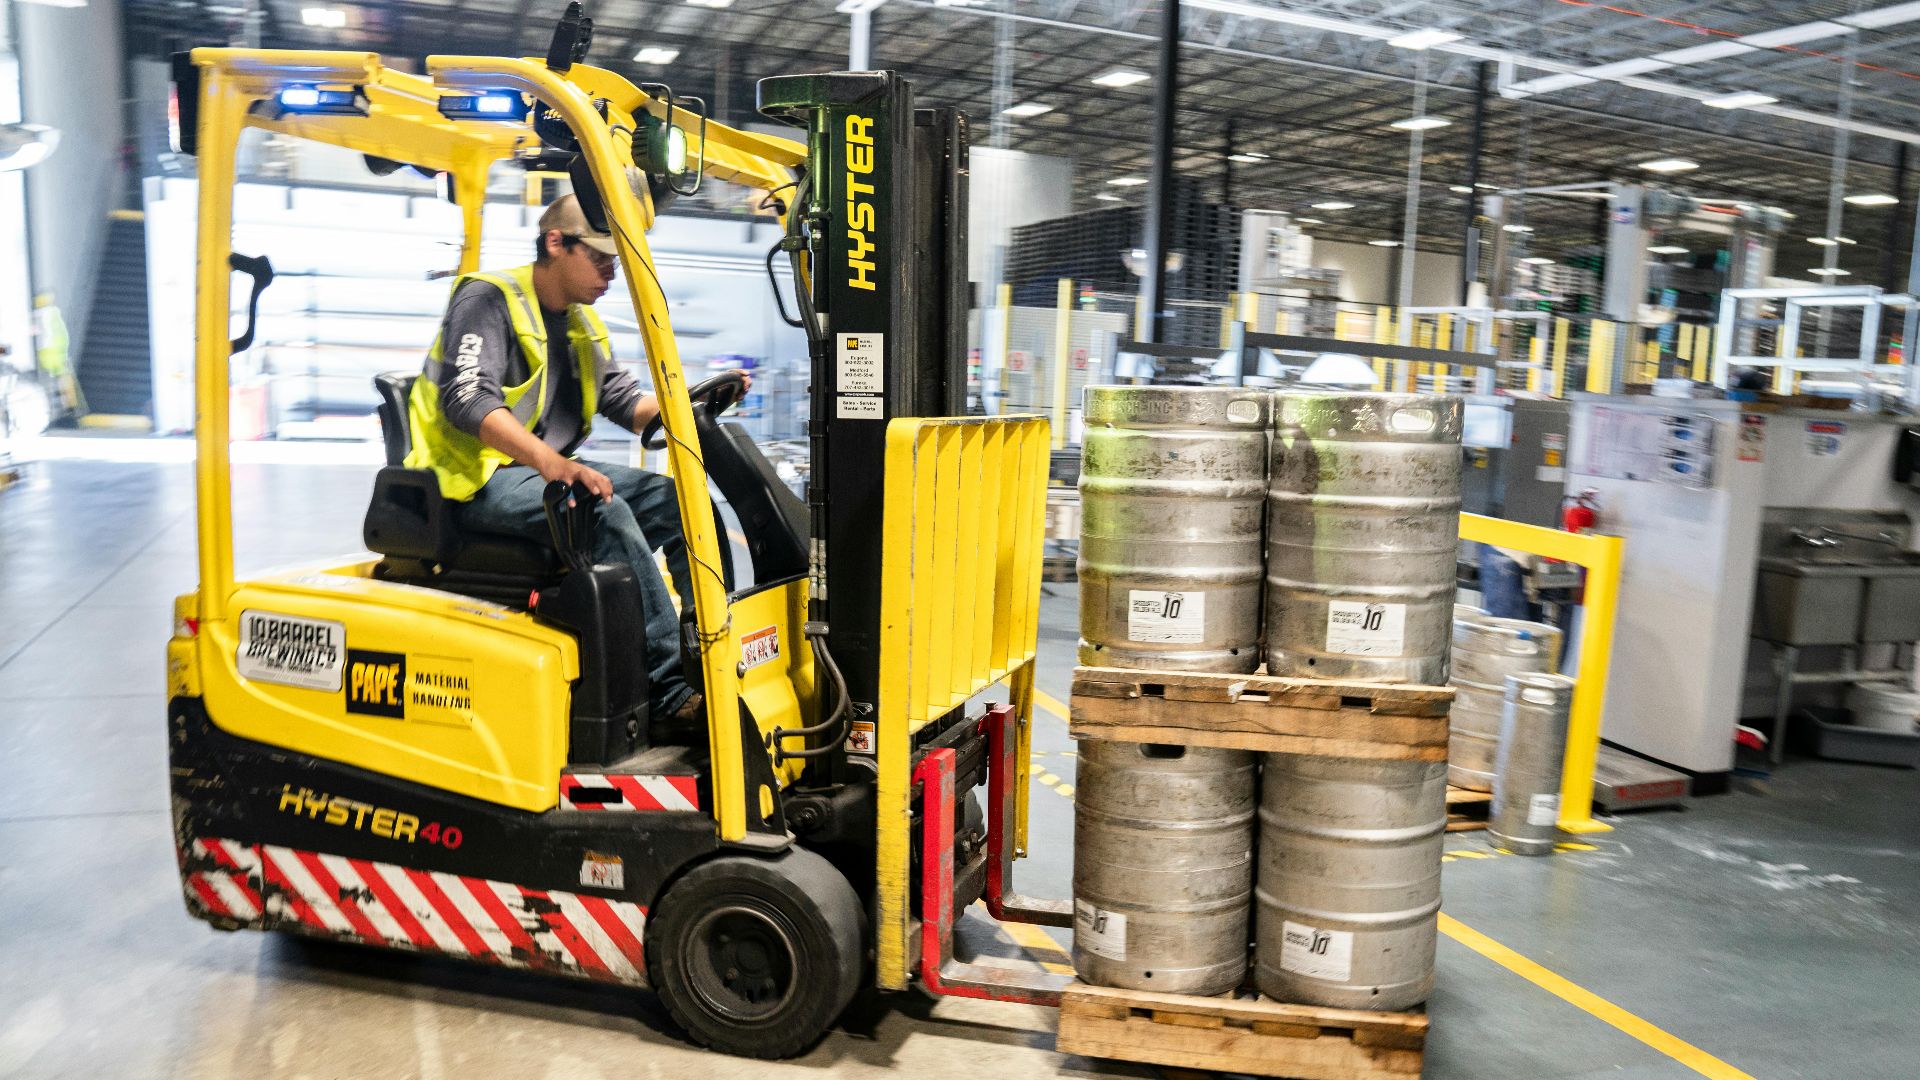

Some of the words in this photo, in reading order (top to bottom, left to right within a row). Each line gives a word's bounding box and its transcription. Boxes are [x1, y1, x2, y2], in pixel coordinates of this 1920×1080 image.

[845, 114, 876, 291] HYSTER
[1161, 597, 1181, 619] 10
[1361, 608, 1382, 630] 10
[415, 671, 470, 691] MATERIAL
[278, 783, 420, 844] HYSTER
[420, 821, 463, 849] 40
[1309, 934, 1330, 955] 10
